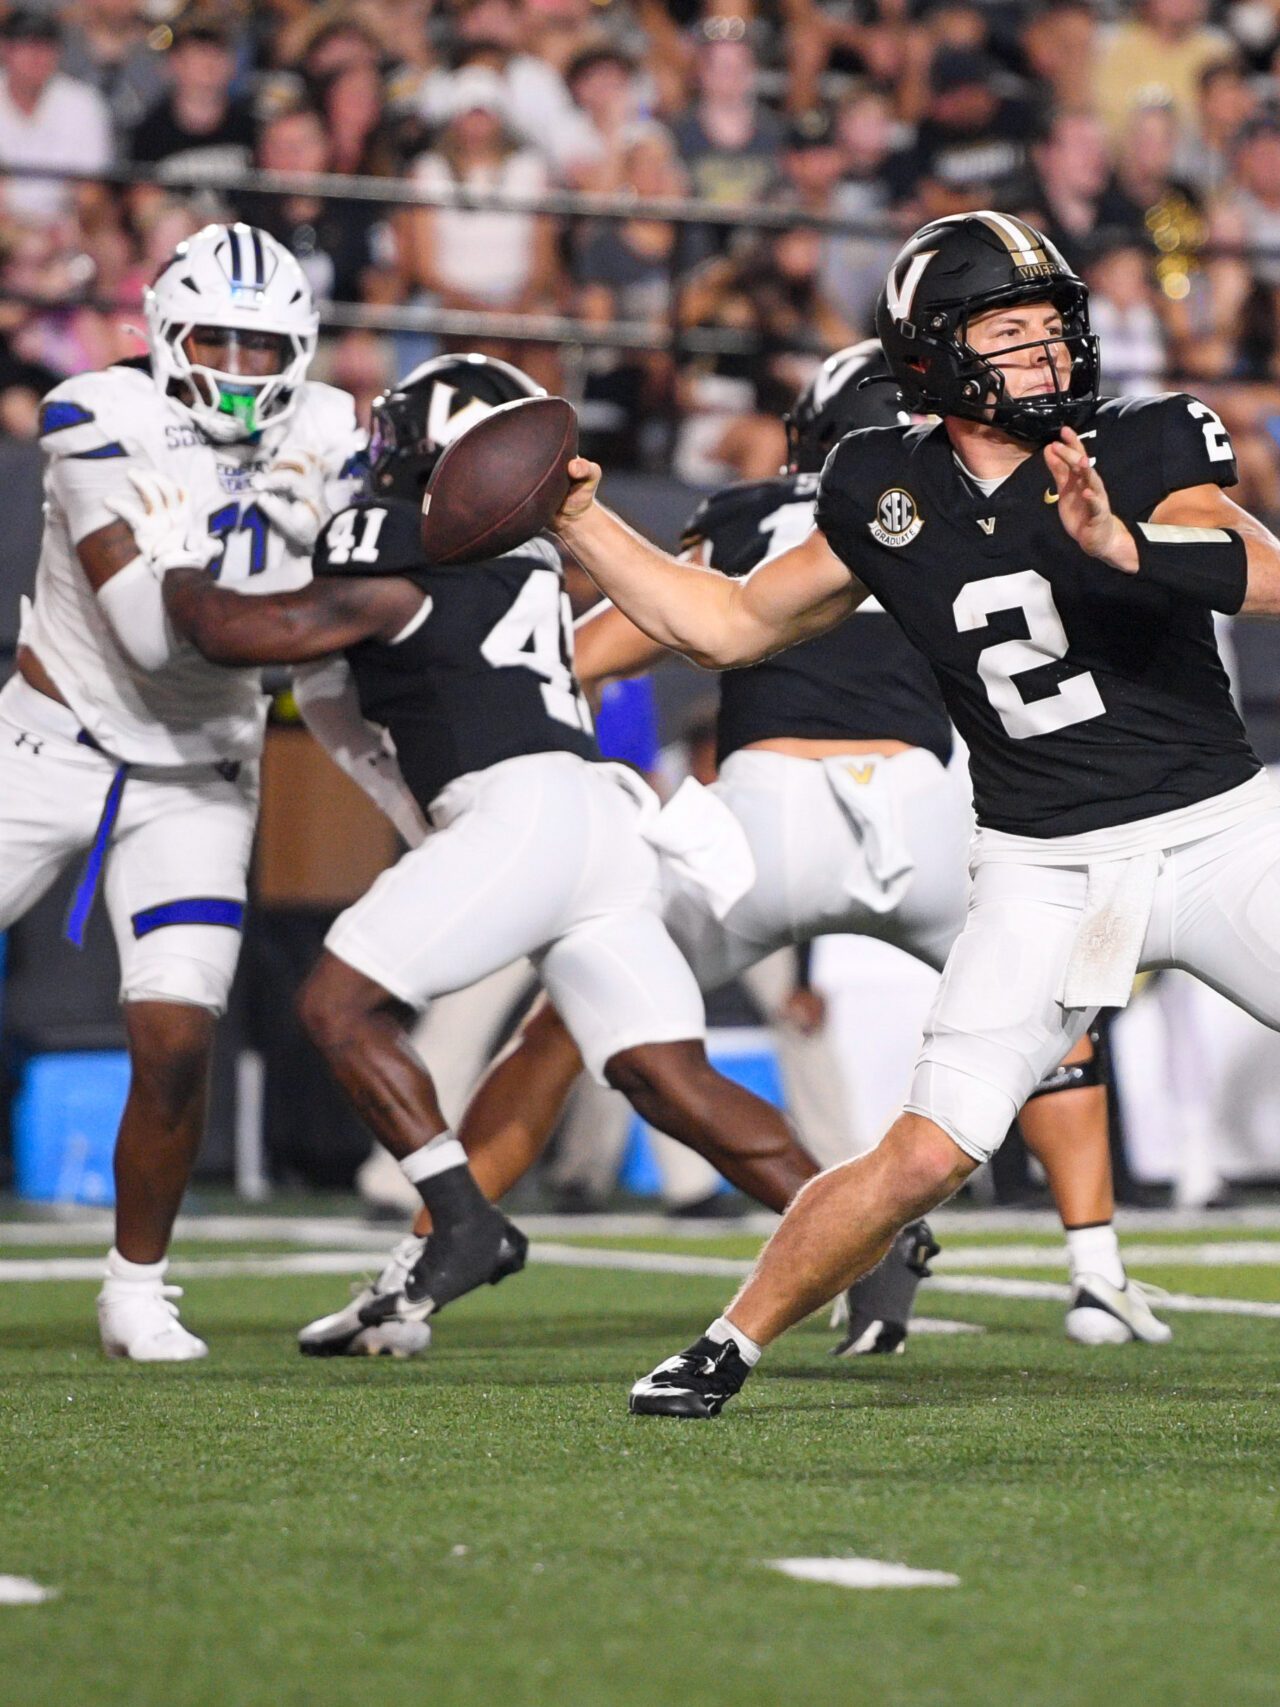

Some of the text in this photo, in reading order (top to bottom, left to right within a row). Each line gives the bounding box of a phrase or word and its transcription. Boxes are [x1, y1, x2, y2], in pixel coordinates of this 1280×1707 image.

[886, 250, 940, 324] V
[1187, 401, 1234, 463] 2
[326, 507, 389, 564] 41
[873, 525, 917, 546] GRADUATE
[880, 491, 913, 532] SEC
[976, 516, 996, 535] V
[952, 569, 1107, 740] 2
